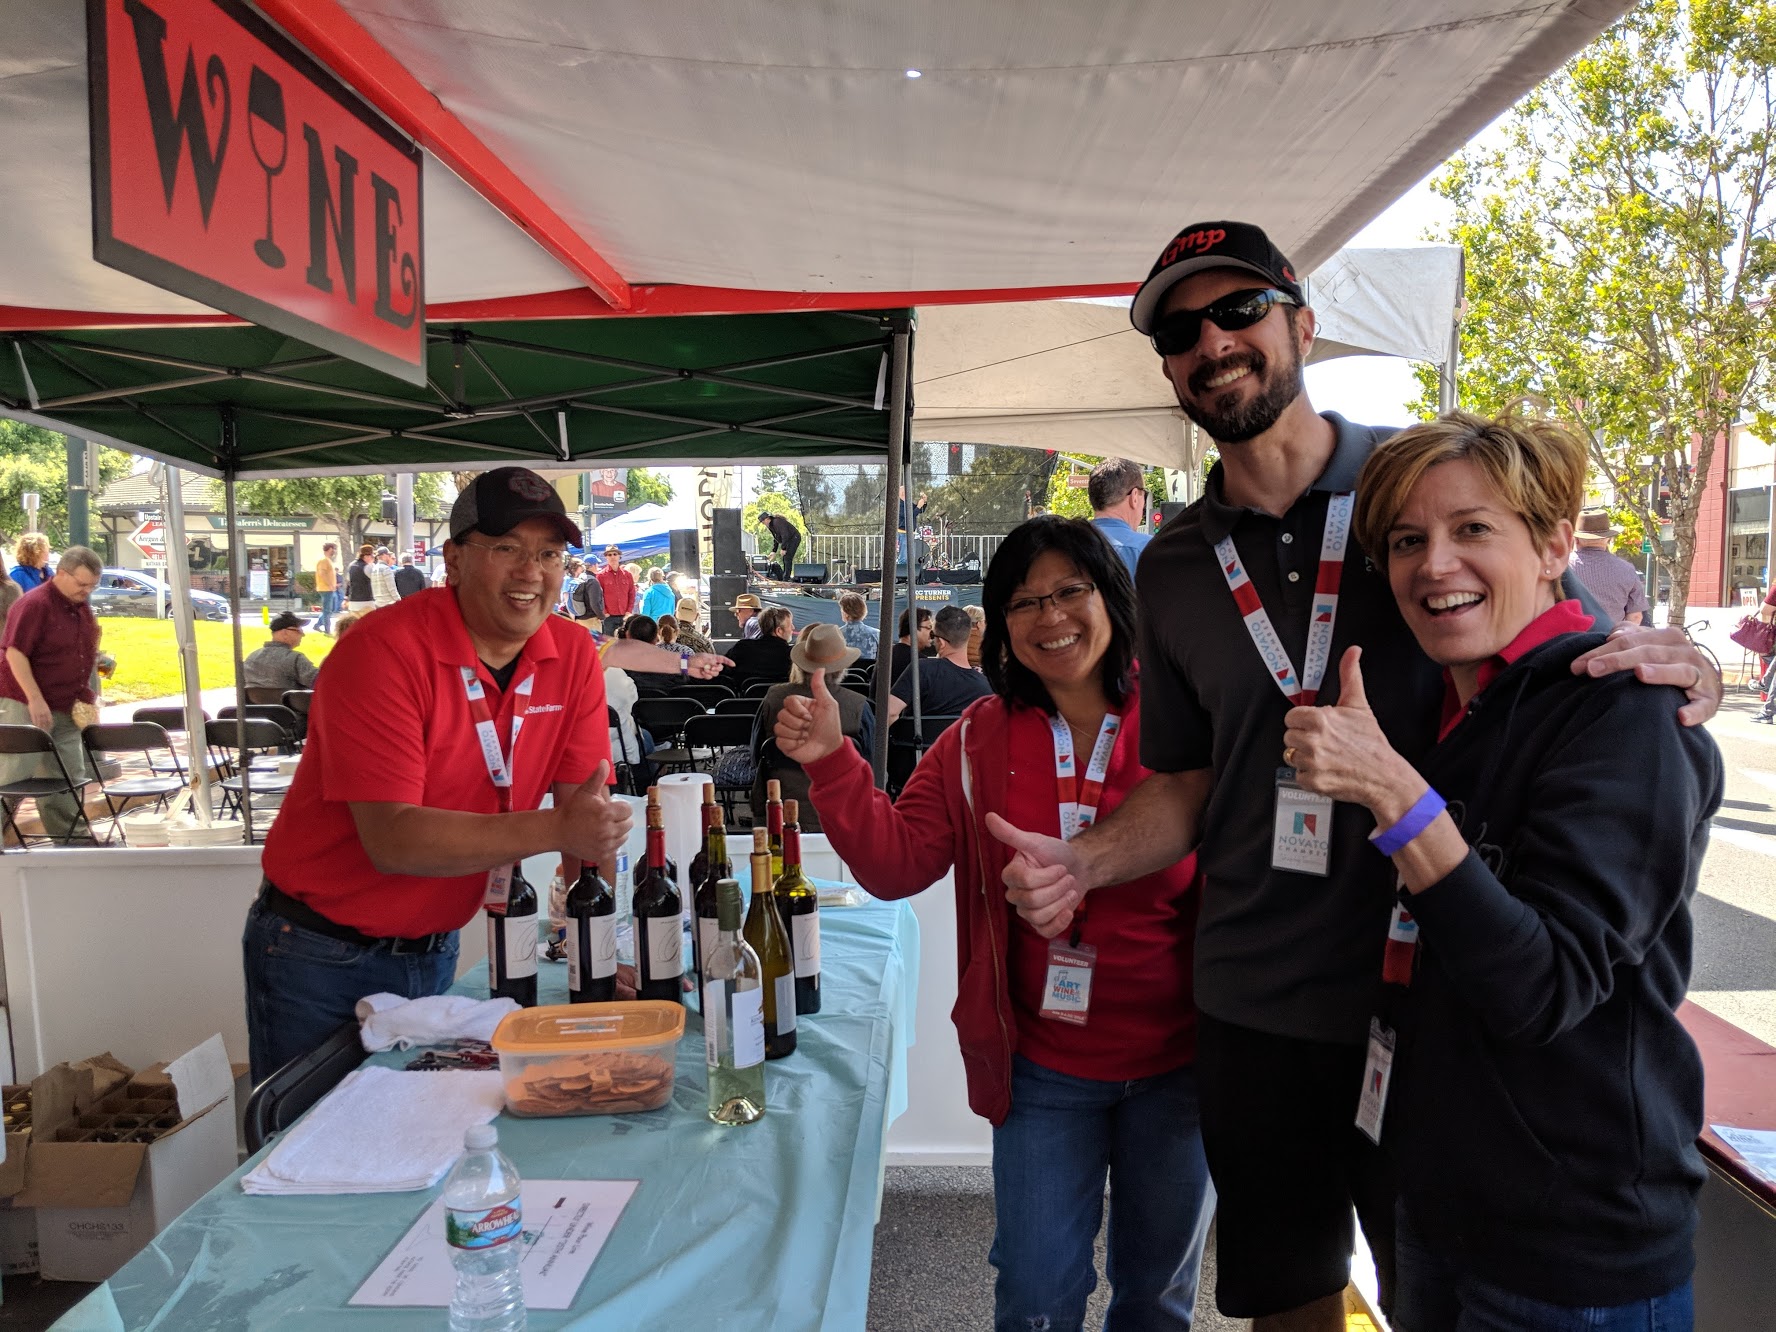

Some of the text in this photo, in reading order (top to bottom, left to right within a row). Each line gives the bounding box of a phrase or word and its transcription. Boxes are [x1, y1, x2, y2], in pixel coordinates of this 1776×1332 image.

[1251, 621, 1282, 671] NOVATO
[1313, 624, 1330, 681] NOVATO
[1279, 835, 1329, 850] NOVATO
[1053, 954, 1089, 968] VOLUNTEER
[1054, 985, 1075, 995] WINE
[1058, 980, 1081, 990] ART
[1052, 991, 1081, 1003] MUSIC
[471, 1210, 521, 1233] ARROWHEA
